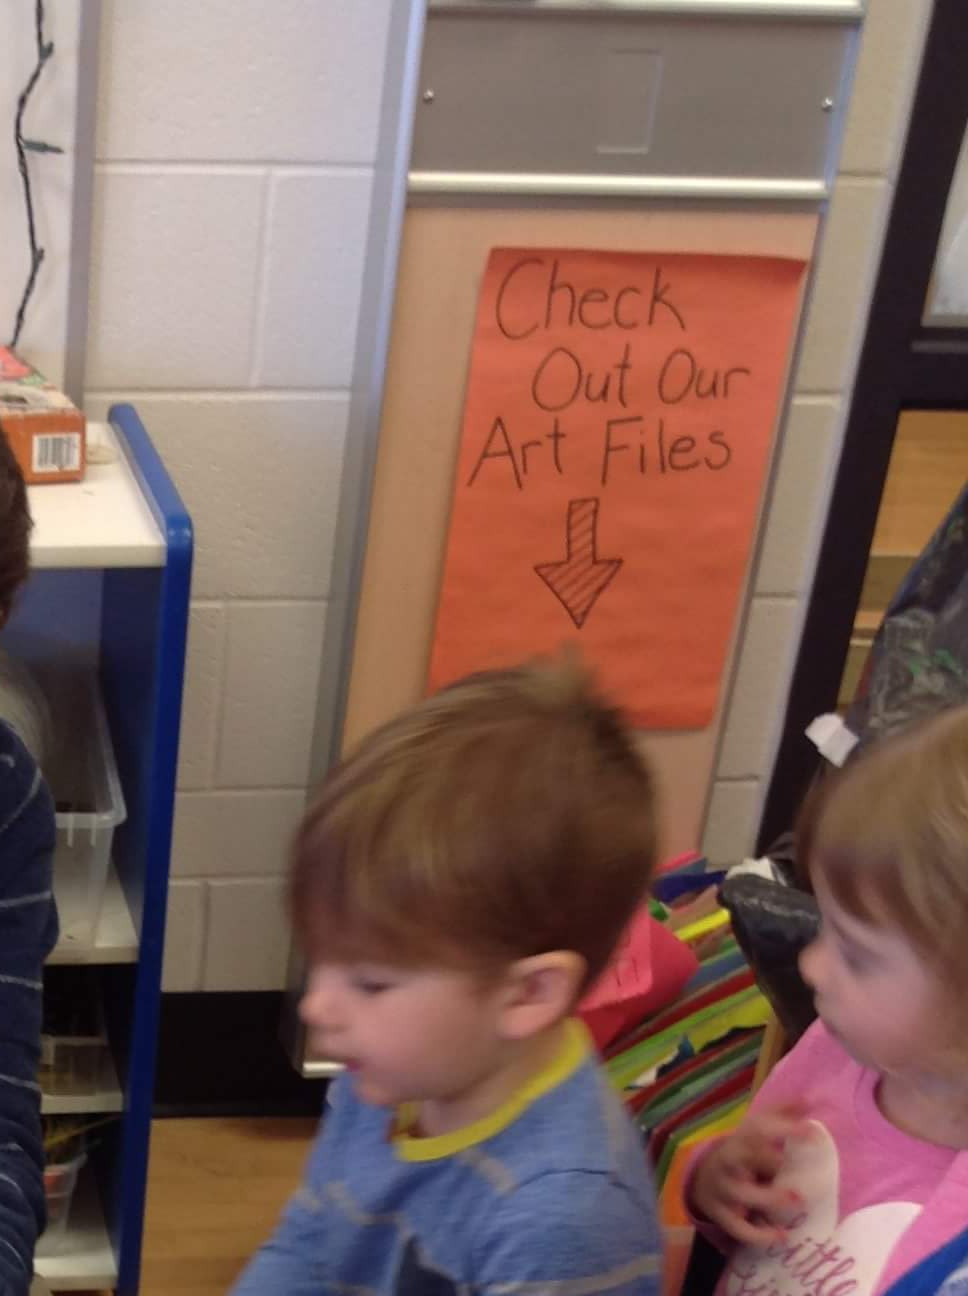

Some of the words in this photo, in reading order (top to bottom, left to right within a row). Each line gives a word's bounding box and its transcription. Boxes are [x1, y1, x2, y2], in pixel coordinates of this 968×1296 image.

[496, 258, 686, 340] Check
[532, 343, 631, 412] Out
[657, 349, 750, 405] Our
[467, 416, 566, 490] Art
[601, 416, 732, 487] Files
